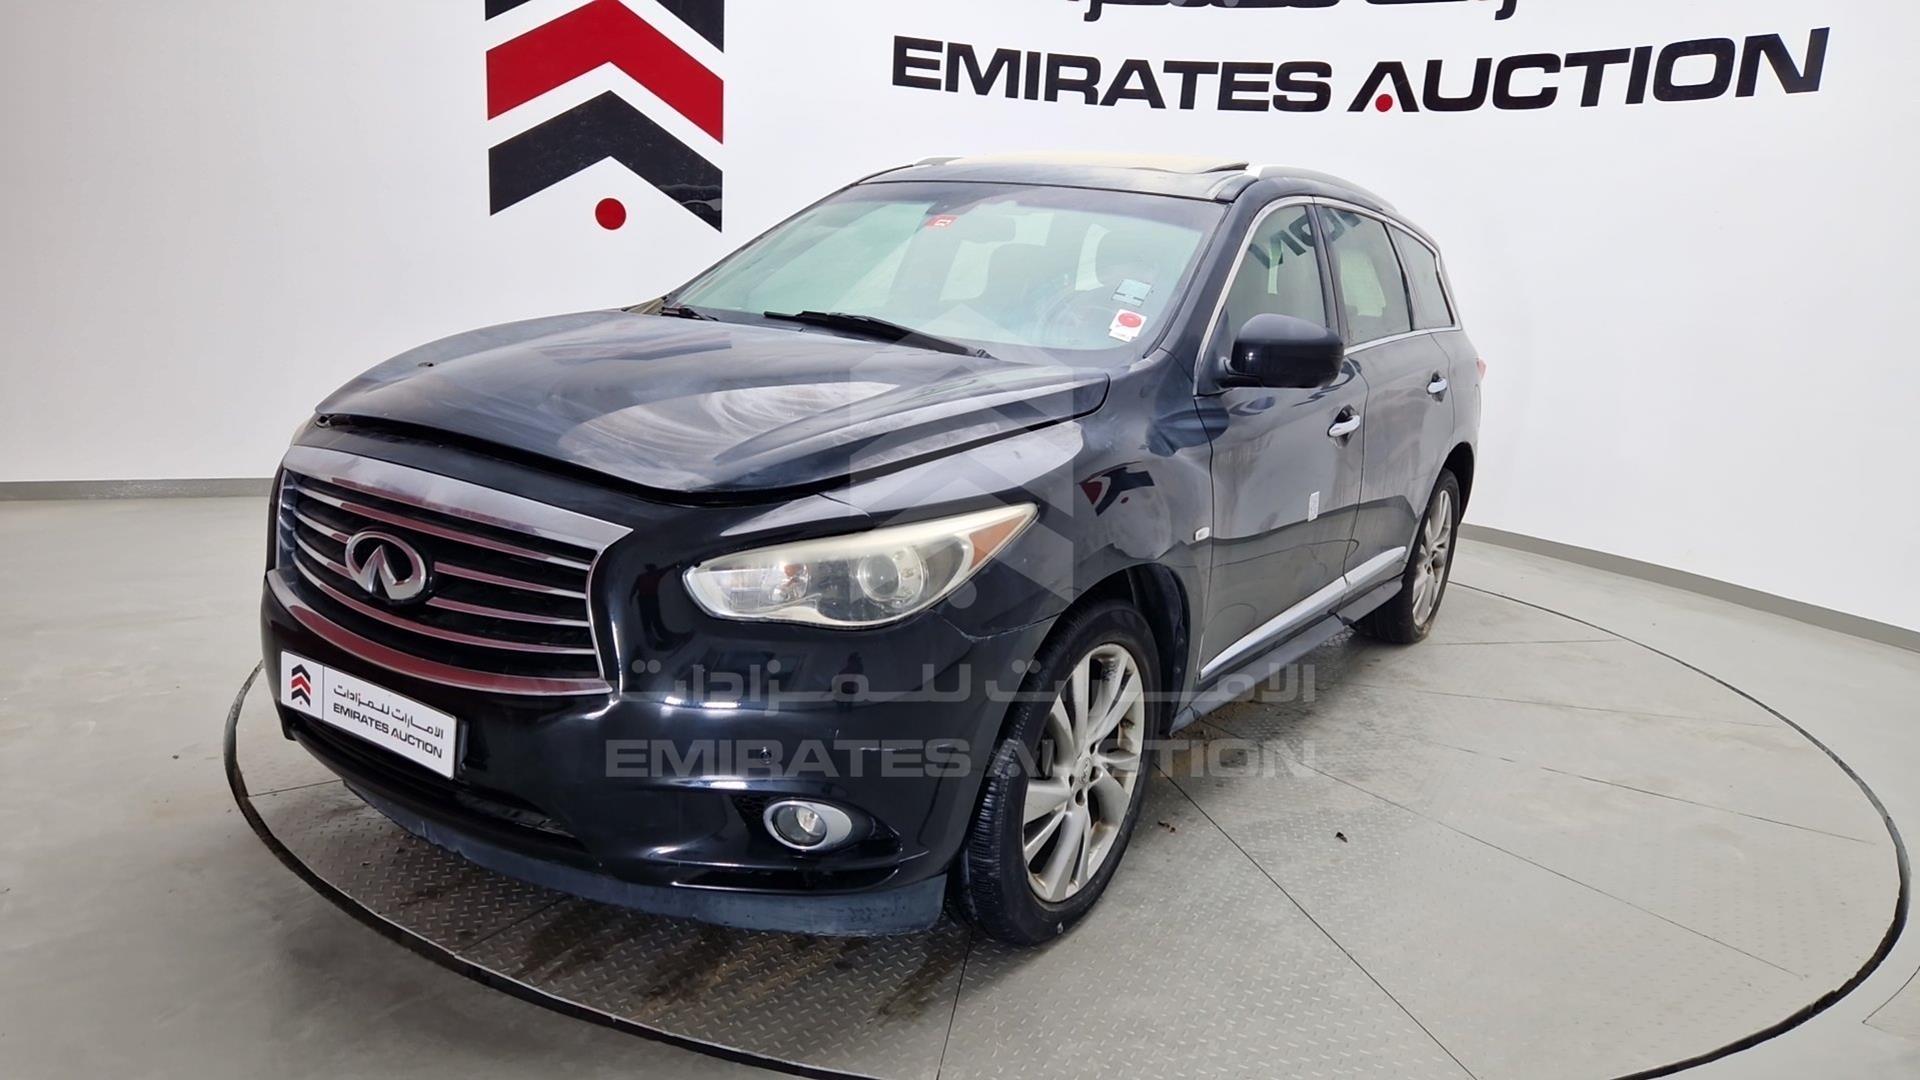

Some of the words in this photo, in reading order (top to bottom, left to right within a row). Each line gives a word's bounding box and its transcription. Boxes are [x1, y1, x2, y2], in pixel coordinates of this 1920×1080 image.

[892, 35, 1333, 113] EMIRATES
[1346, 27, 1831, 113] AUCTION
[333, 702, 389, 735] EMIRATES
[391, 727, 443, 759] AUCTION
